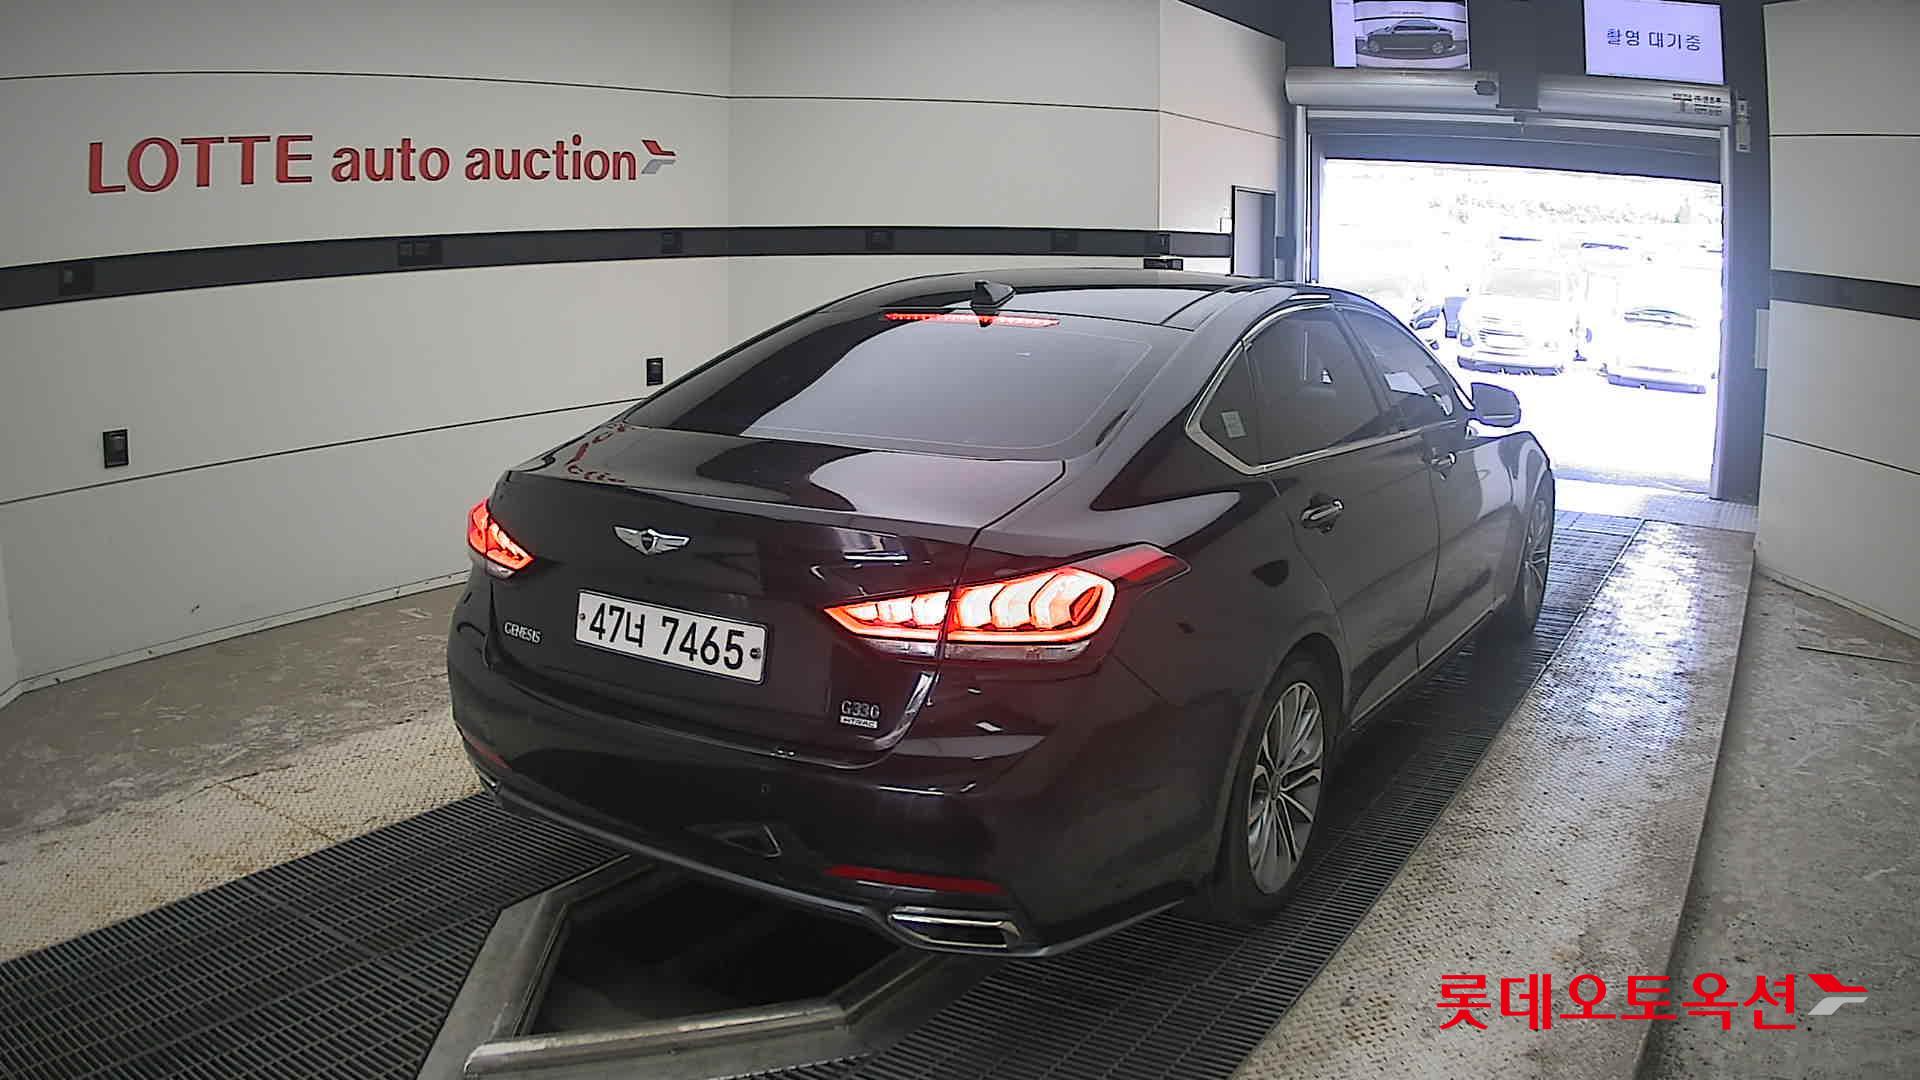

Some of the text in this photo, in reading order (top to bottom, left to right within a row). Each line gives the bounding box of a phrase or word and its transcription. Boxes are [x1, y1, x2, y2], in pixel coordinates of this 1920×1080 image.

[1648, 31, 1701, 52] 대기중
[89, 134, 636, 194] LOTTE auto auction
[504, 621, 541, 644] GENESIS
[588, 602, 745, 671] 47너 7465
